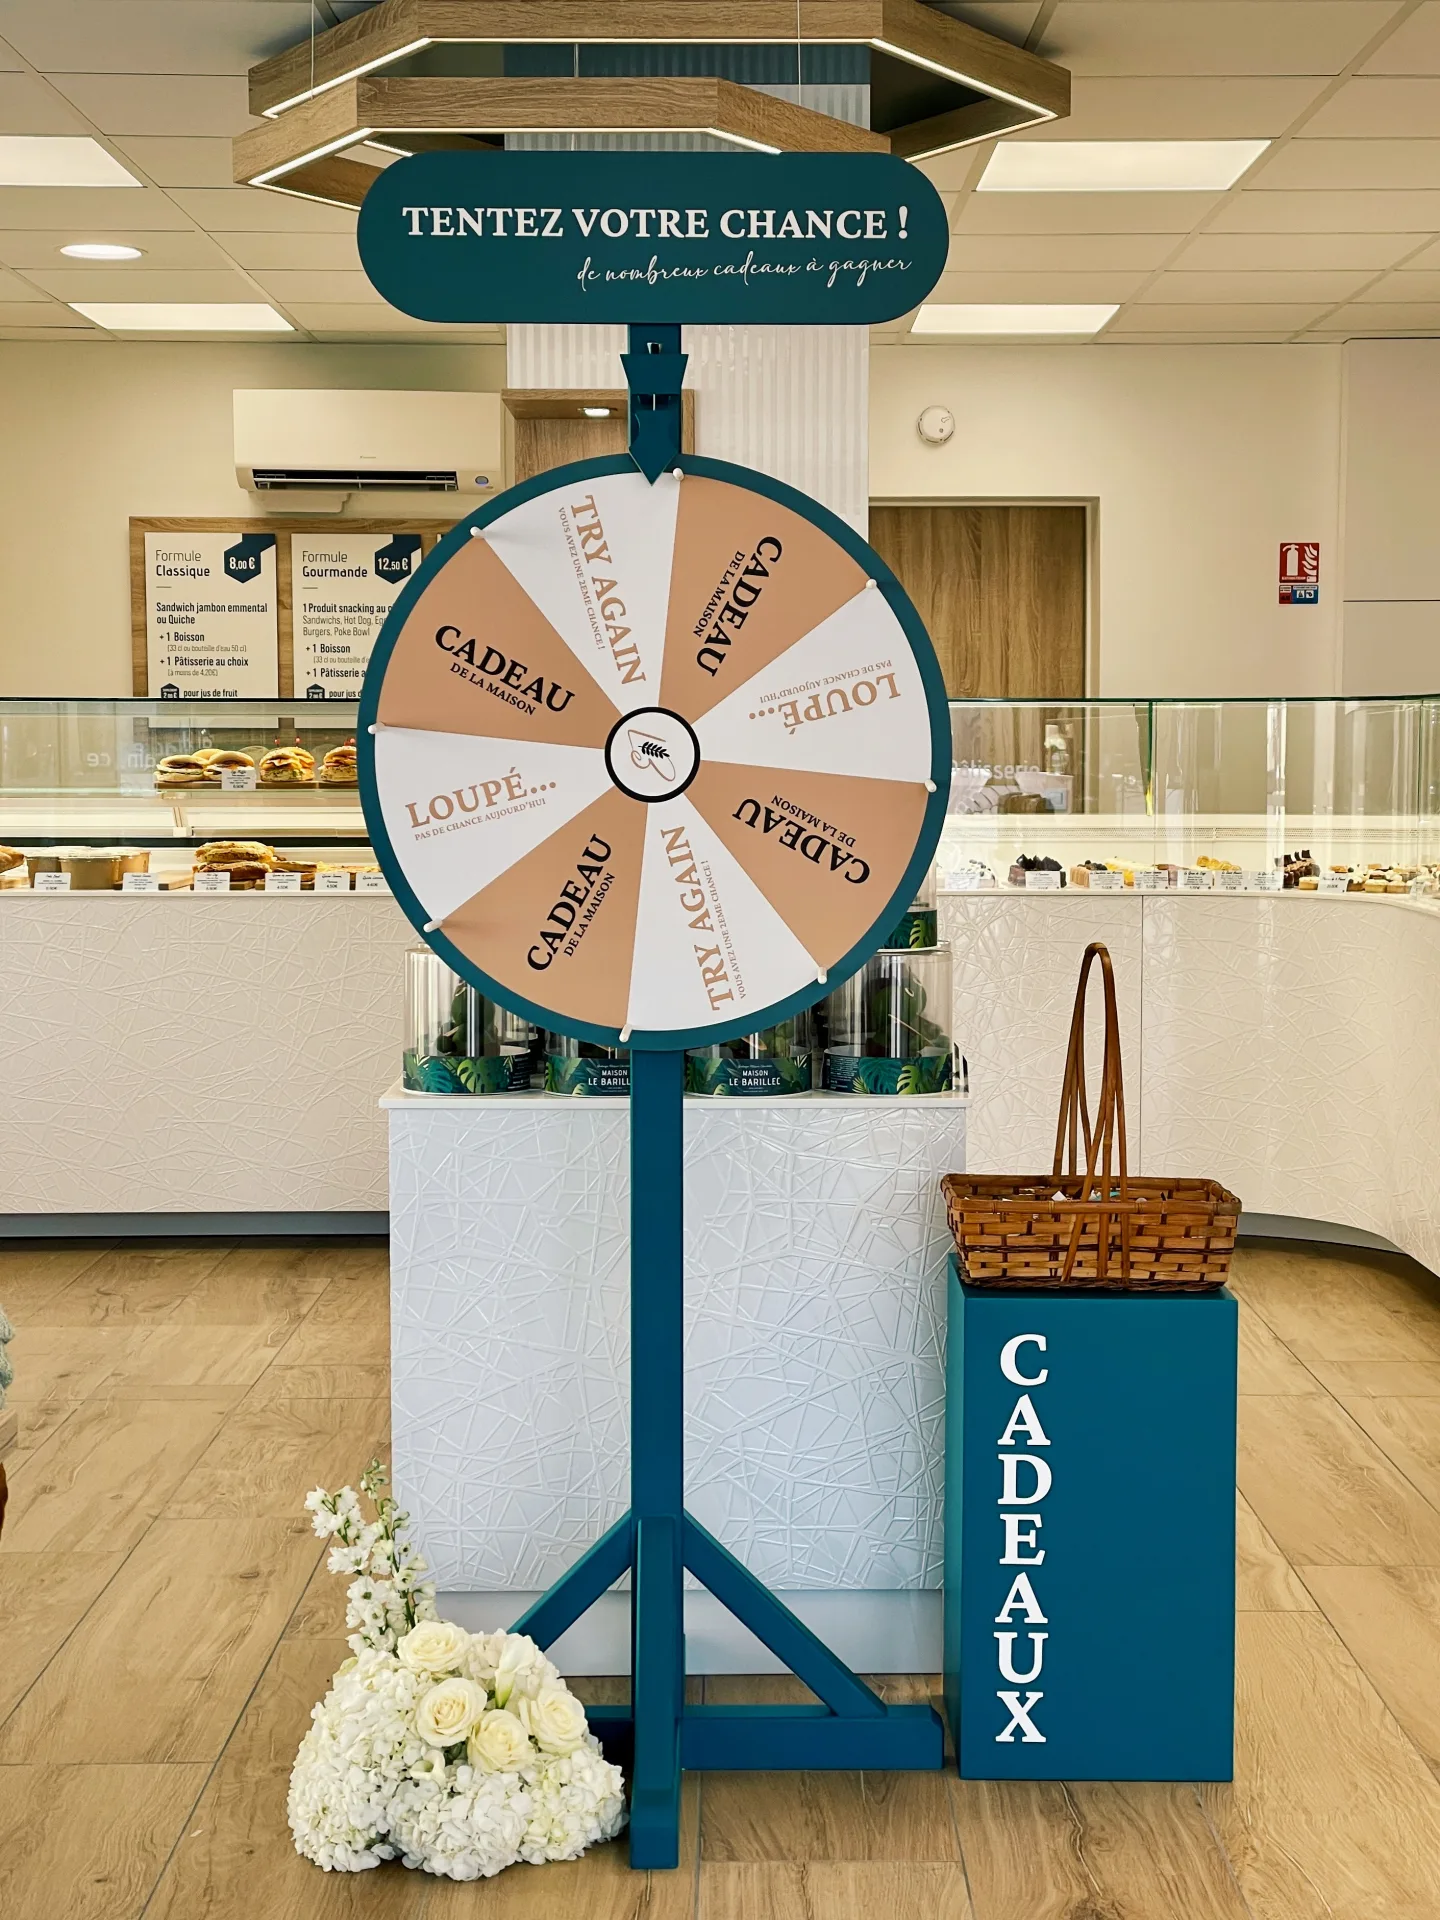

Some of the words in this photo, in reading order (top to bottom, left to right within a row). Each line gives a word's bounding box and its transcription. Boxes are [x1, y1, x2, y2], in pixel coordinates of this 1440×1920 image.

[402, 206, 563, 237] TENTEZ
[573, 208, 709, 239] VOTRE
[720, 209, 888, 240] CHANCE
[577, 258, 600, 292] de
[606, 255, 707, 283] nombreux
[714, 251, 801, 287] cadeaux
[806, 257, 823, 272] à
[828, 258, 912, 288] gagner
[156, 550, 201, 562] Formule
[302, 551, 347, 562] Formule
[729, 550, 745, 570] DE
[156, 565, 210, 579] Classique
[302, 566, 368, 578] Gourmande
[558, 507, 571, 533] VOUS
[565, 534, 578, 557] AVEZ
[572, 558, 584, 579] UNE
[578, 580, 592, 606] 2EME
[586, 607, 604, 646] CHANCE
[719, 569, 735, 585] LA
[571, 495, 612, 564] TRY
[592, 576, 646, 685] AGAIN
[156, 602, 194, 612] Sandwich
[196, 603, 226, 614] jambon
[228, 603, 267, 612] emmental
[303, 604, 307, 612] 1
[308, 604, 337, 613] Produit
[339, 604, 374, 615] snacking
[693, 586, 726, 638] MAISON
[697, 536, 783, 677] CADEAU
[157, 616, 166, 624] ou
[168, 614, 195, 626] Quiche
[303, 616, 342, 624] Sandwichs,
[344, 616, 356, 624] Hot
[167, 632, 170, 641] 1
[174, 632, 205, 641] Boisson
[303, 627, 332, 637] Burgers,
[334, 627, 351, 636] Poke
[353, 627, 370, 636] Bowl
[313, 644, 316, 652] 1
[321, 644, 350, 653] Boisson
[167, 657, 170, 665] 1
[175, 656, 213, 666] Pâtisserie
[228, 657, 248, 666] choix
[435, 625, 575, 712] CADEAU
[862, 664, 875, 674] DE
[876, 660, 892, 670] PAS
[313, 669, 316, 677] 1
[321, 668, 359, 677] Pâtisserie
[823, 669, 860, 685] CHANCE
[201, 689, 211, 697] jus
[213, 689, 220, 697] de
[223, 689, 237, 697] fruit
[346, 690, 356, 698] jus
[451, 662, 468, 679] DE
[469, 672, 484, 688] LA
[486, 682, 536, 716] MAISON
[759, 680, 821, 704] AUJOURD'HUI
[414, 830, 431, 841] PAS
[432, 827, 445, 836] DE
[446, 815, 483, 832] CHANCE
[484, 797, 546, 820] AUJOURD'HUI
[771, 795, 821, 828] MAISON
[822, 822, 838, 838] LA
[732, 798, 870, 884] CADEAU
[837, 831, 856, 848] DE
[660, 826, 714, 932] AGAIN
[703, 865, 719, 902] CHANCE
[527, 834, 612, 970] CADEAU
[563, 938, 579, 957] DE
[573, 923, 589, 939] LA
[582, 872, 616, 922] MAISON
[721, 930, 732, 949] UNE
[728, 950, 739, 973] AVEZ
[693, 944, 734, 1010] TRY
[734, 973, 746, 999] VOUS
[601, 1069, 628, 1077] MAISON
[742, 1069, 769, 1077] MAISON
[588, 1077, 598, 1086] LE
[729, 1078, 739, 1086] LE
[741, 1077, 781, 1086] BARILLEC
[993, 1333, 1053, 1744] CADEAUX
